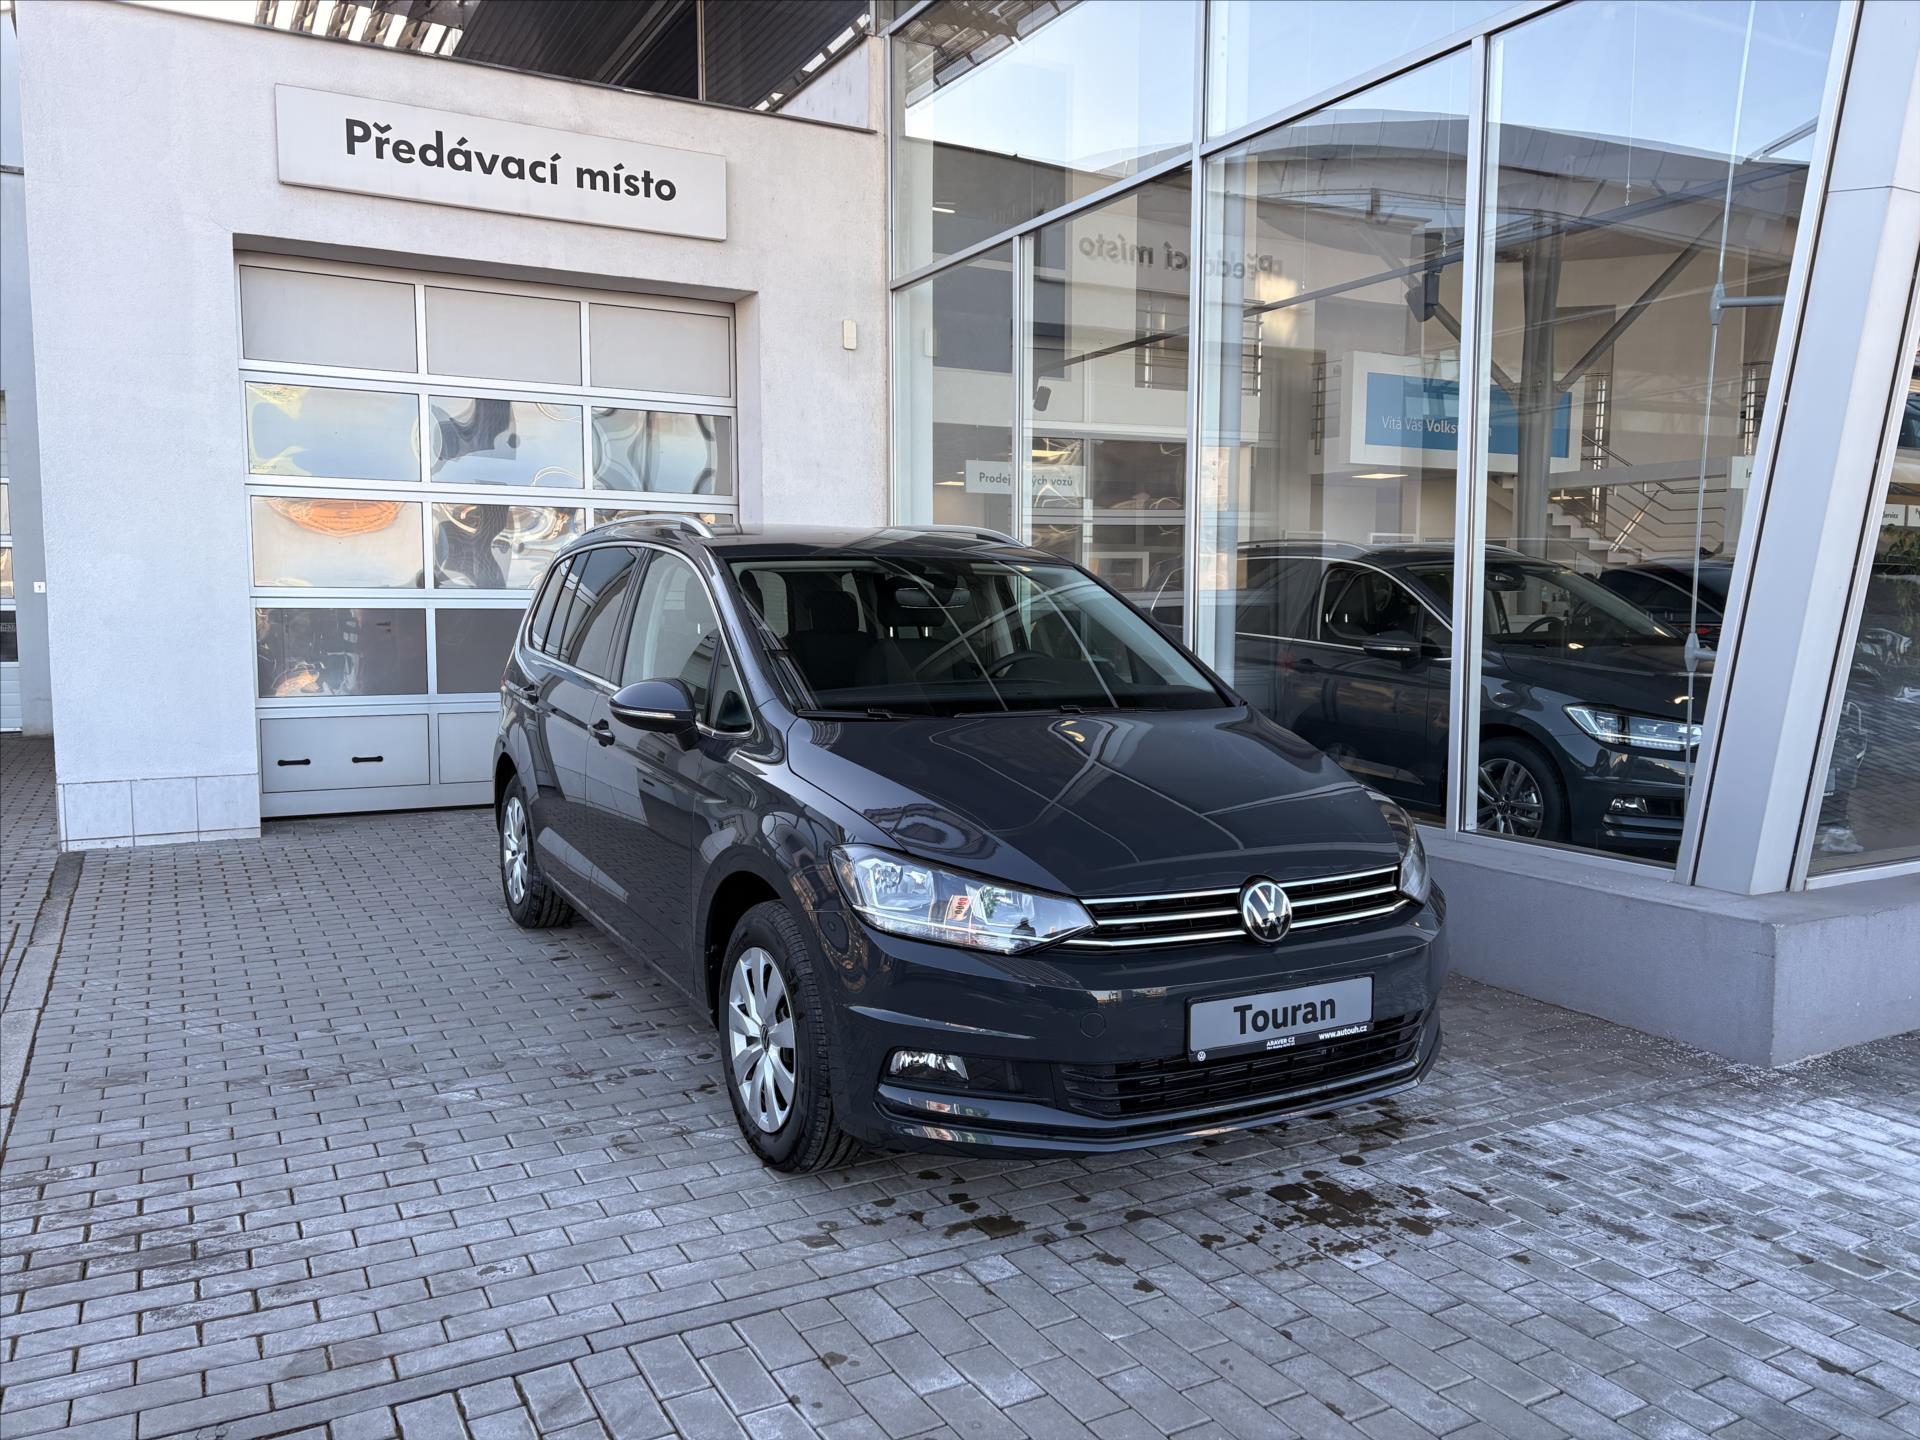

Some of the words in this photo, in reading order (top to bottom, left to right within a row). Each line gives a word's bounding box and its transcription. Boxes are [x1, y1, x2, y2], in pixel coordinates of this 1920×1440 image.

[345, 118, 562, 185] Předávací
[576, 163, 677, 201] místo
[979, 472, 1011, 486] Prodej
[1051, 476, 1073, 486] vozů
[1233, 998, 1336, 1035] Touran
[1318, 1025, 1368, 1041] www.autouh.cz
